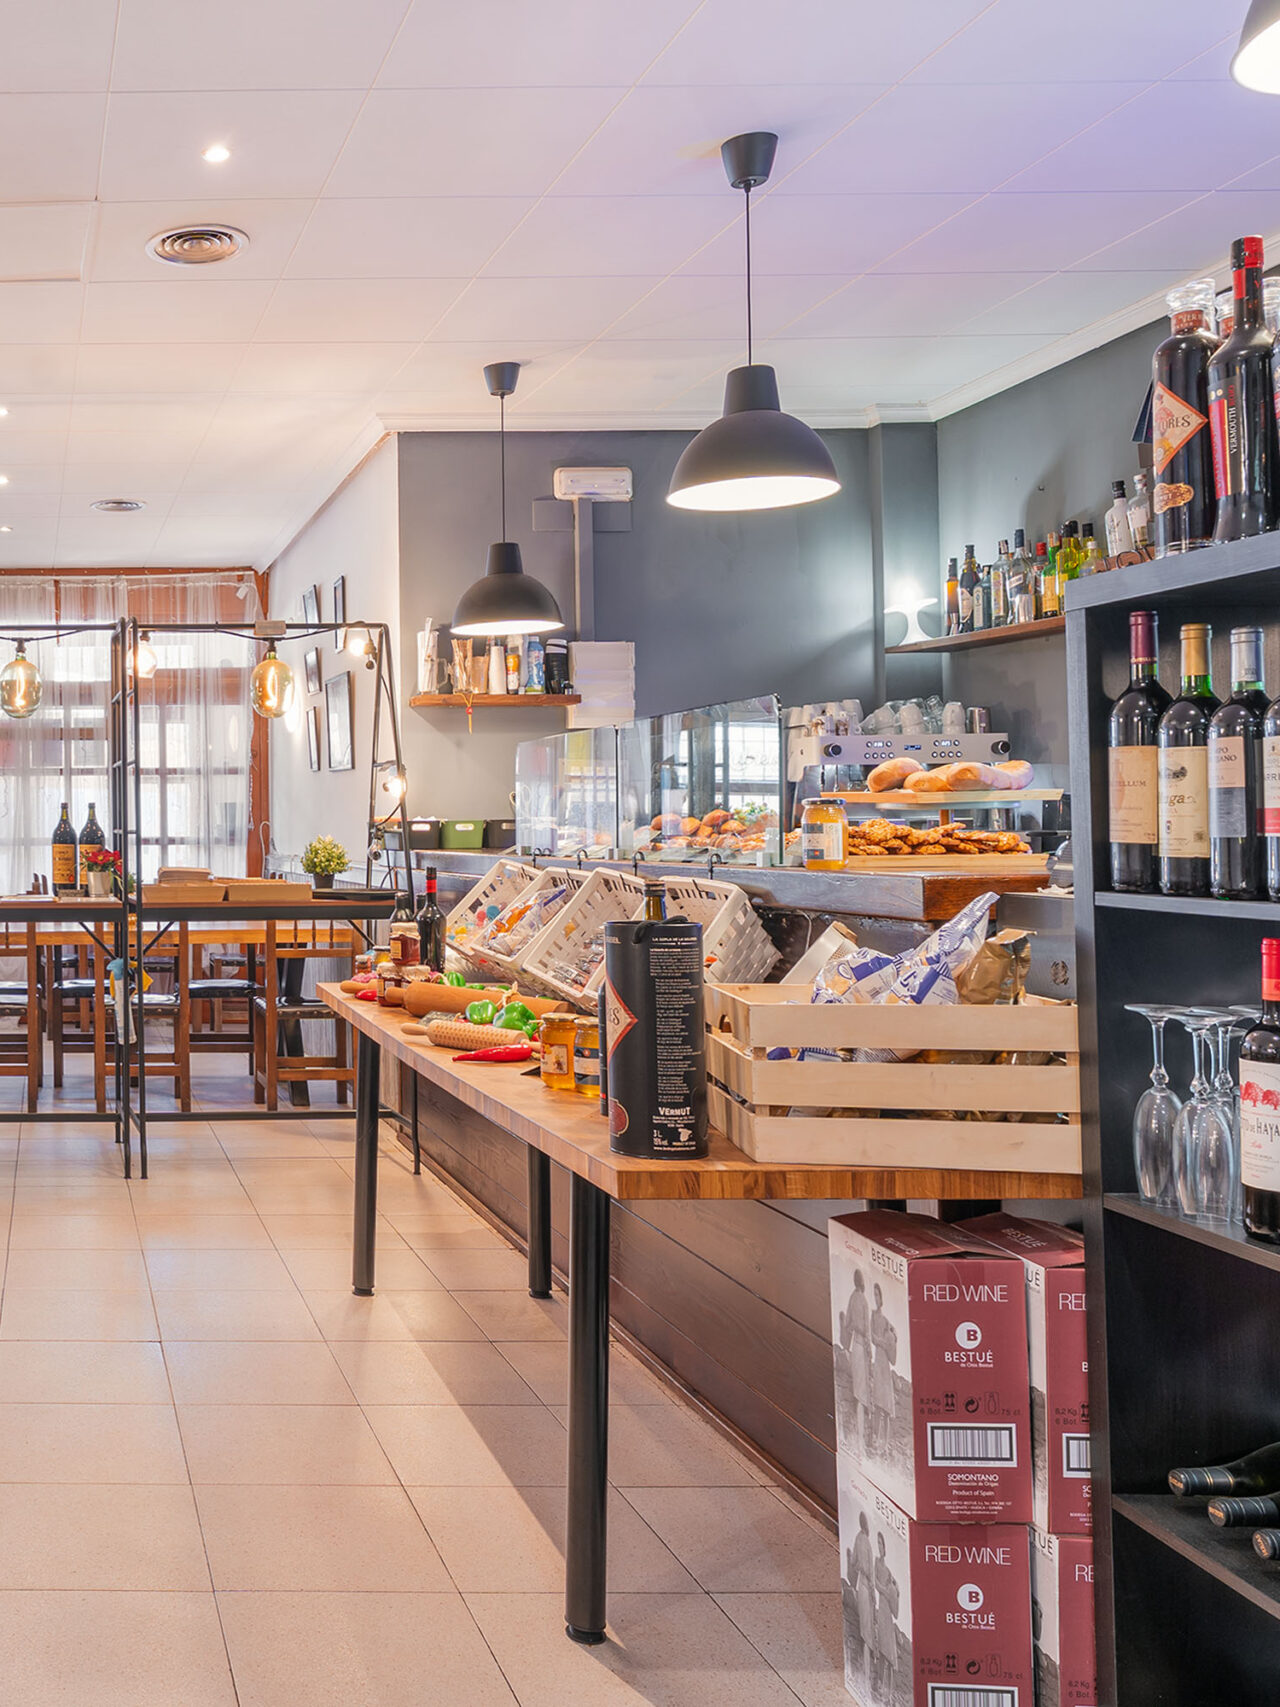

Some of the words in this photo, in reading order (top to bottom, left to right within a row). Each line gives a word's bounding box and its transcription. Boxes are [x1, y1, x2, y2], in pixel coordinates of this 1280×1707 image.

[1229, 407, 1238, 454] VERMOUTH
[658, 1107, 690, 1115] VERMUT
[871, 1247, 904, 1278] BESTUÉ
[923, 1285, 959, 1302] RED
[962, 1285, 1008, 1302] WINE
[967, 1330, 978, 1341] B
[944, 1350, 993, 1362] BESTUÉ
[947, 1473, 999, 1481] SOMONTANO
[875, 1496, 907, 1537] BESTUÉ
[925, 1545, 961, 1563] RED
[965, 1547, 1012, 1565] WINE
[1075, 1564, 1094, 1582] RE
[968, 1591, 980, 1603] B
[946, 1612, 995, 1625] BESTUÉ
